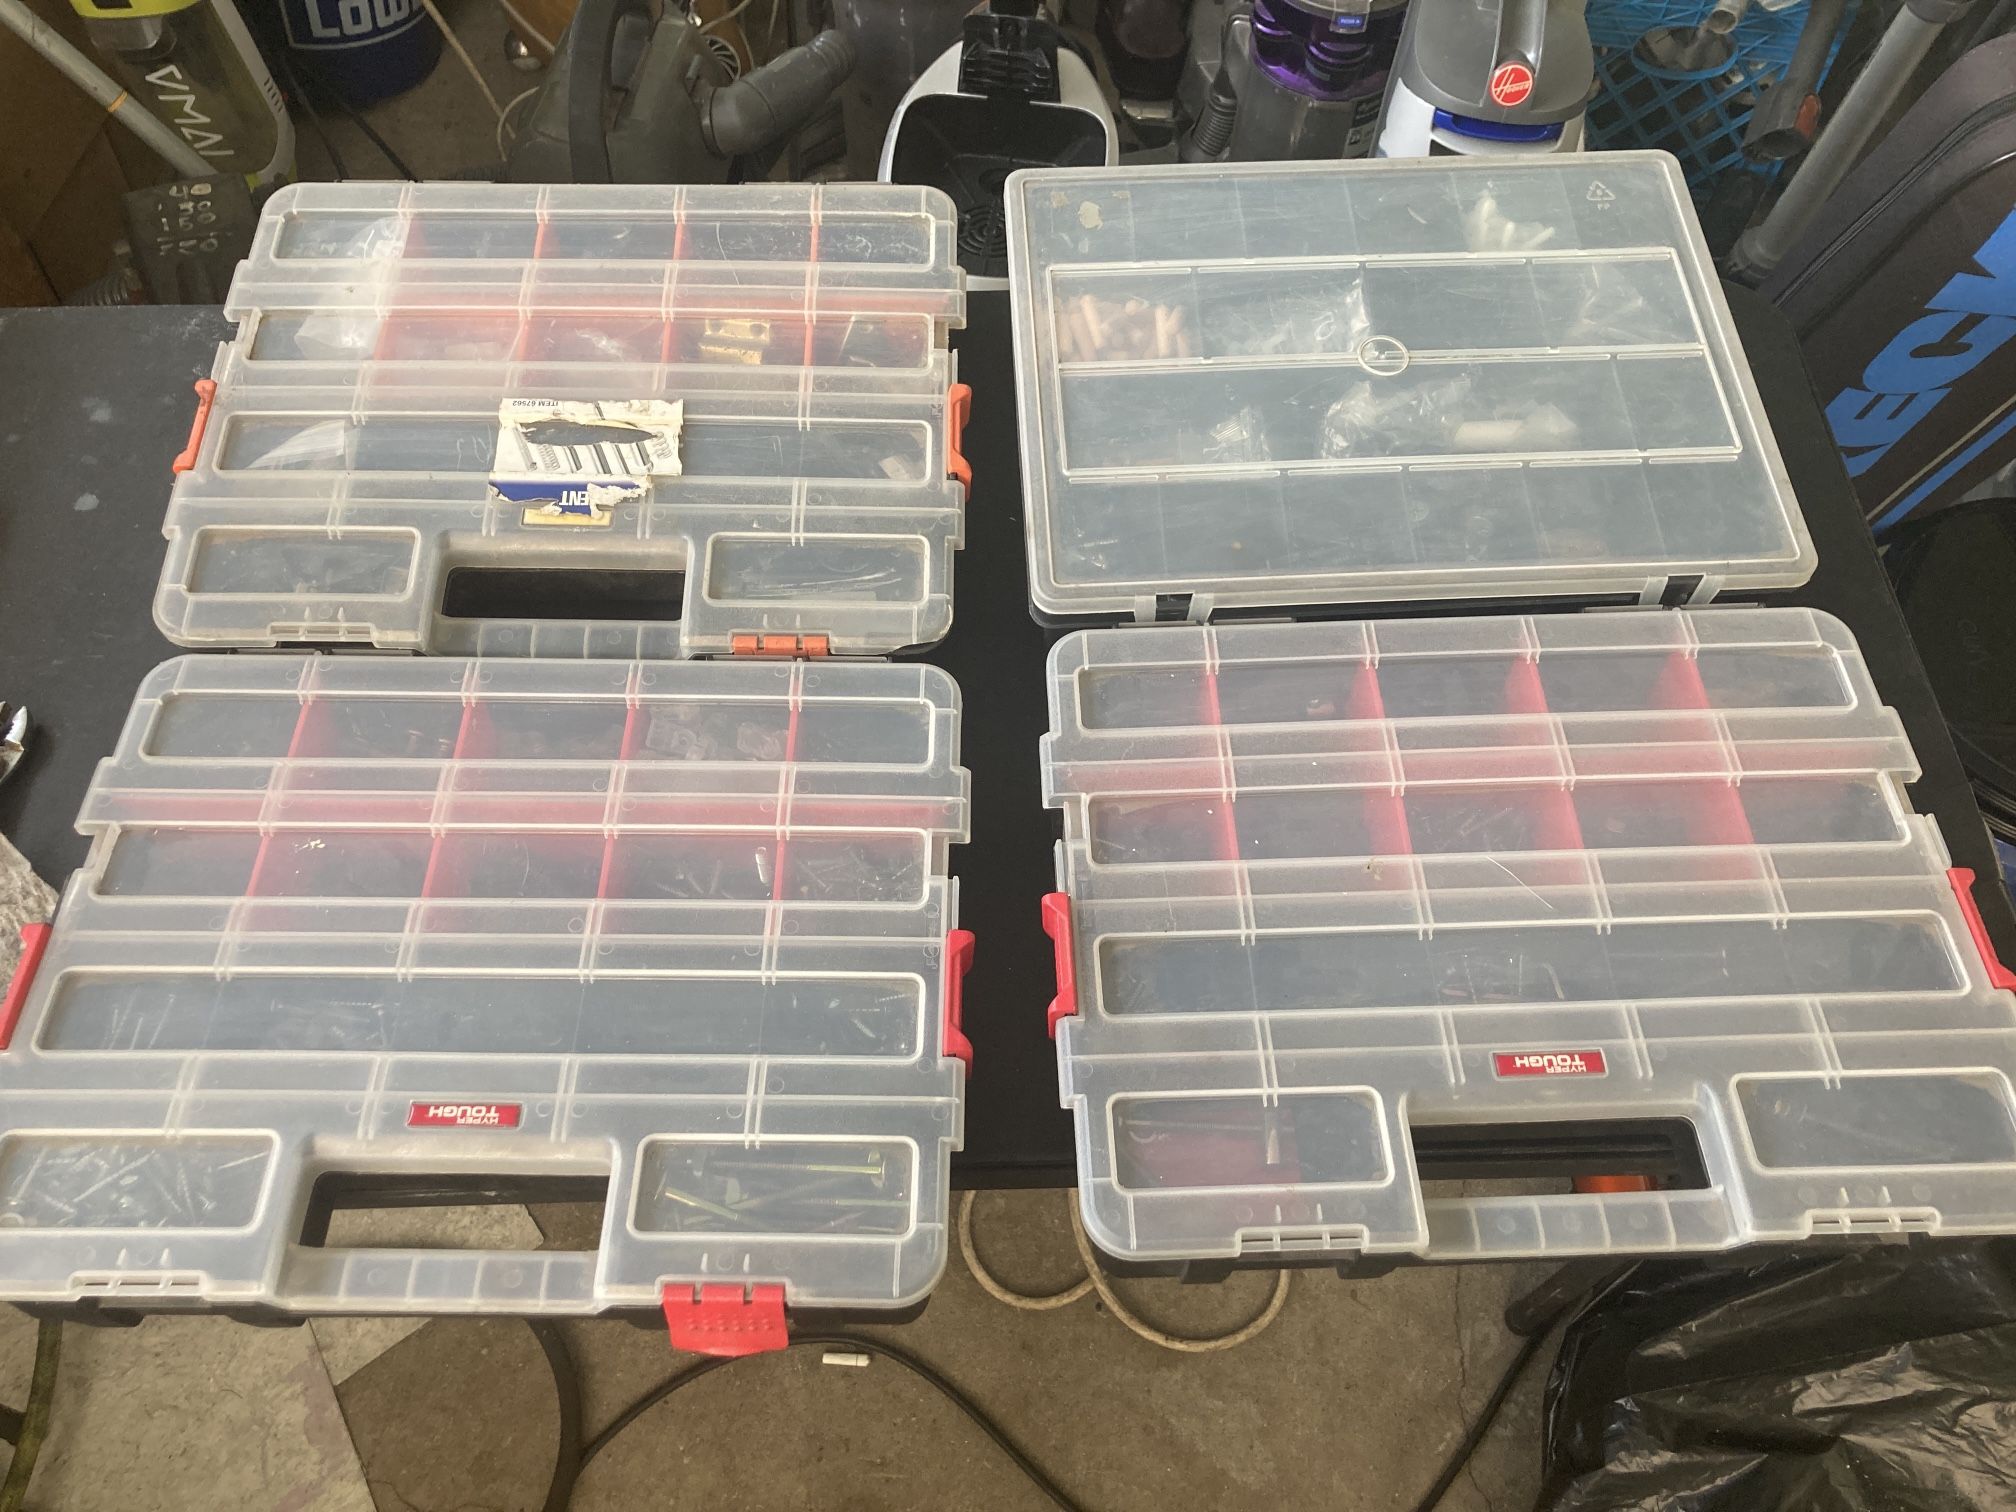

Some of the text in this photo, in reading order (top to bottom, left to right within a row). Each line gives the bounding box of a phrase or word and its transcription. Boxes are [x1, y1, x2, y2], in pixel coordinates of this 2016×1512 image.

[305, 0, 422, 38] LOW
[1514, 1054, 1585, 1068] TOUGH
[1546, 1065, 1587, 1074] HYPER
[428, 1105, 500, 1118] TOUGH
[456, 1116, 499, 1125] HYPER
